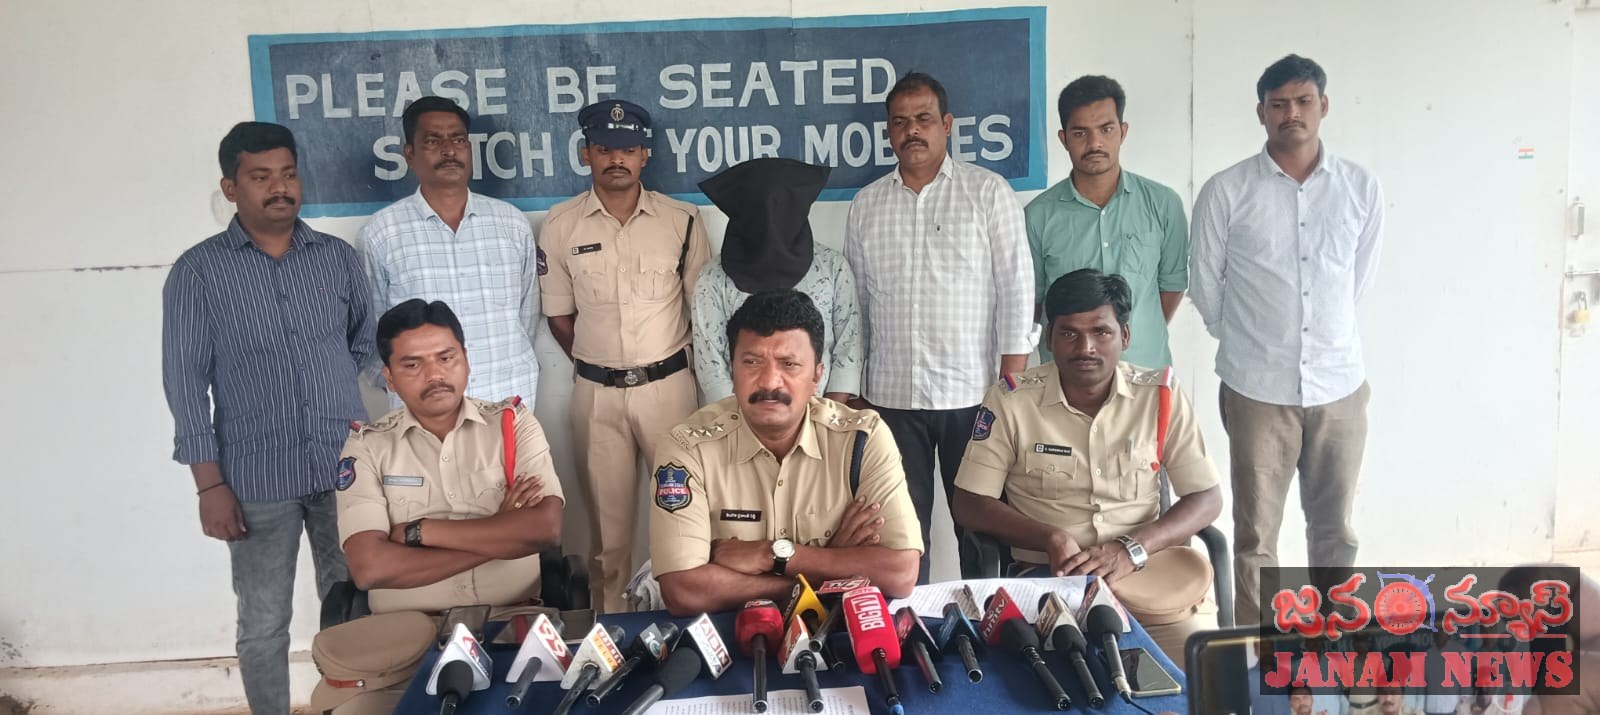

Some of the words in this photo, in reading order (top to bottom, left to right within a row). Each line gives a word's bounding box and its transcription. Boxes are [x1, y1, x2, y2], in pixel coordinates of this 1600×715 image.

[286, 68, 508, 120] PLEASE
[547, 66, 617, 113] BE
[659, 58, 897, 109] SEATED
[373, 131, 554, 180] STCH
[665, 125, 782, 173] YOUR
[804, 114, 1013, 168] MOBES
[659, 487, 688, 496] POLICE
